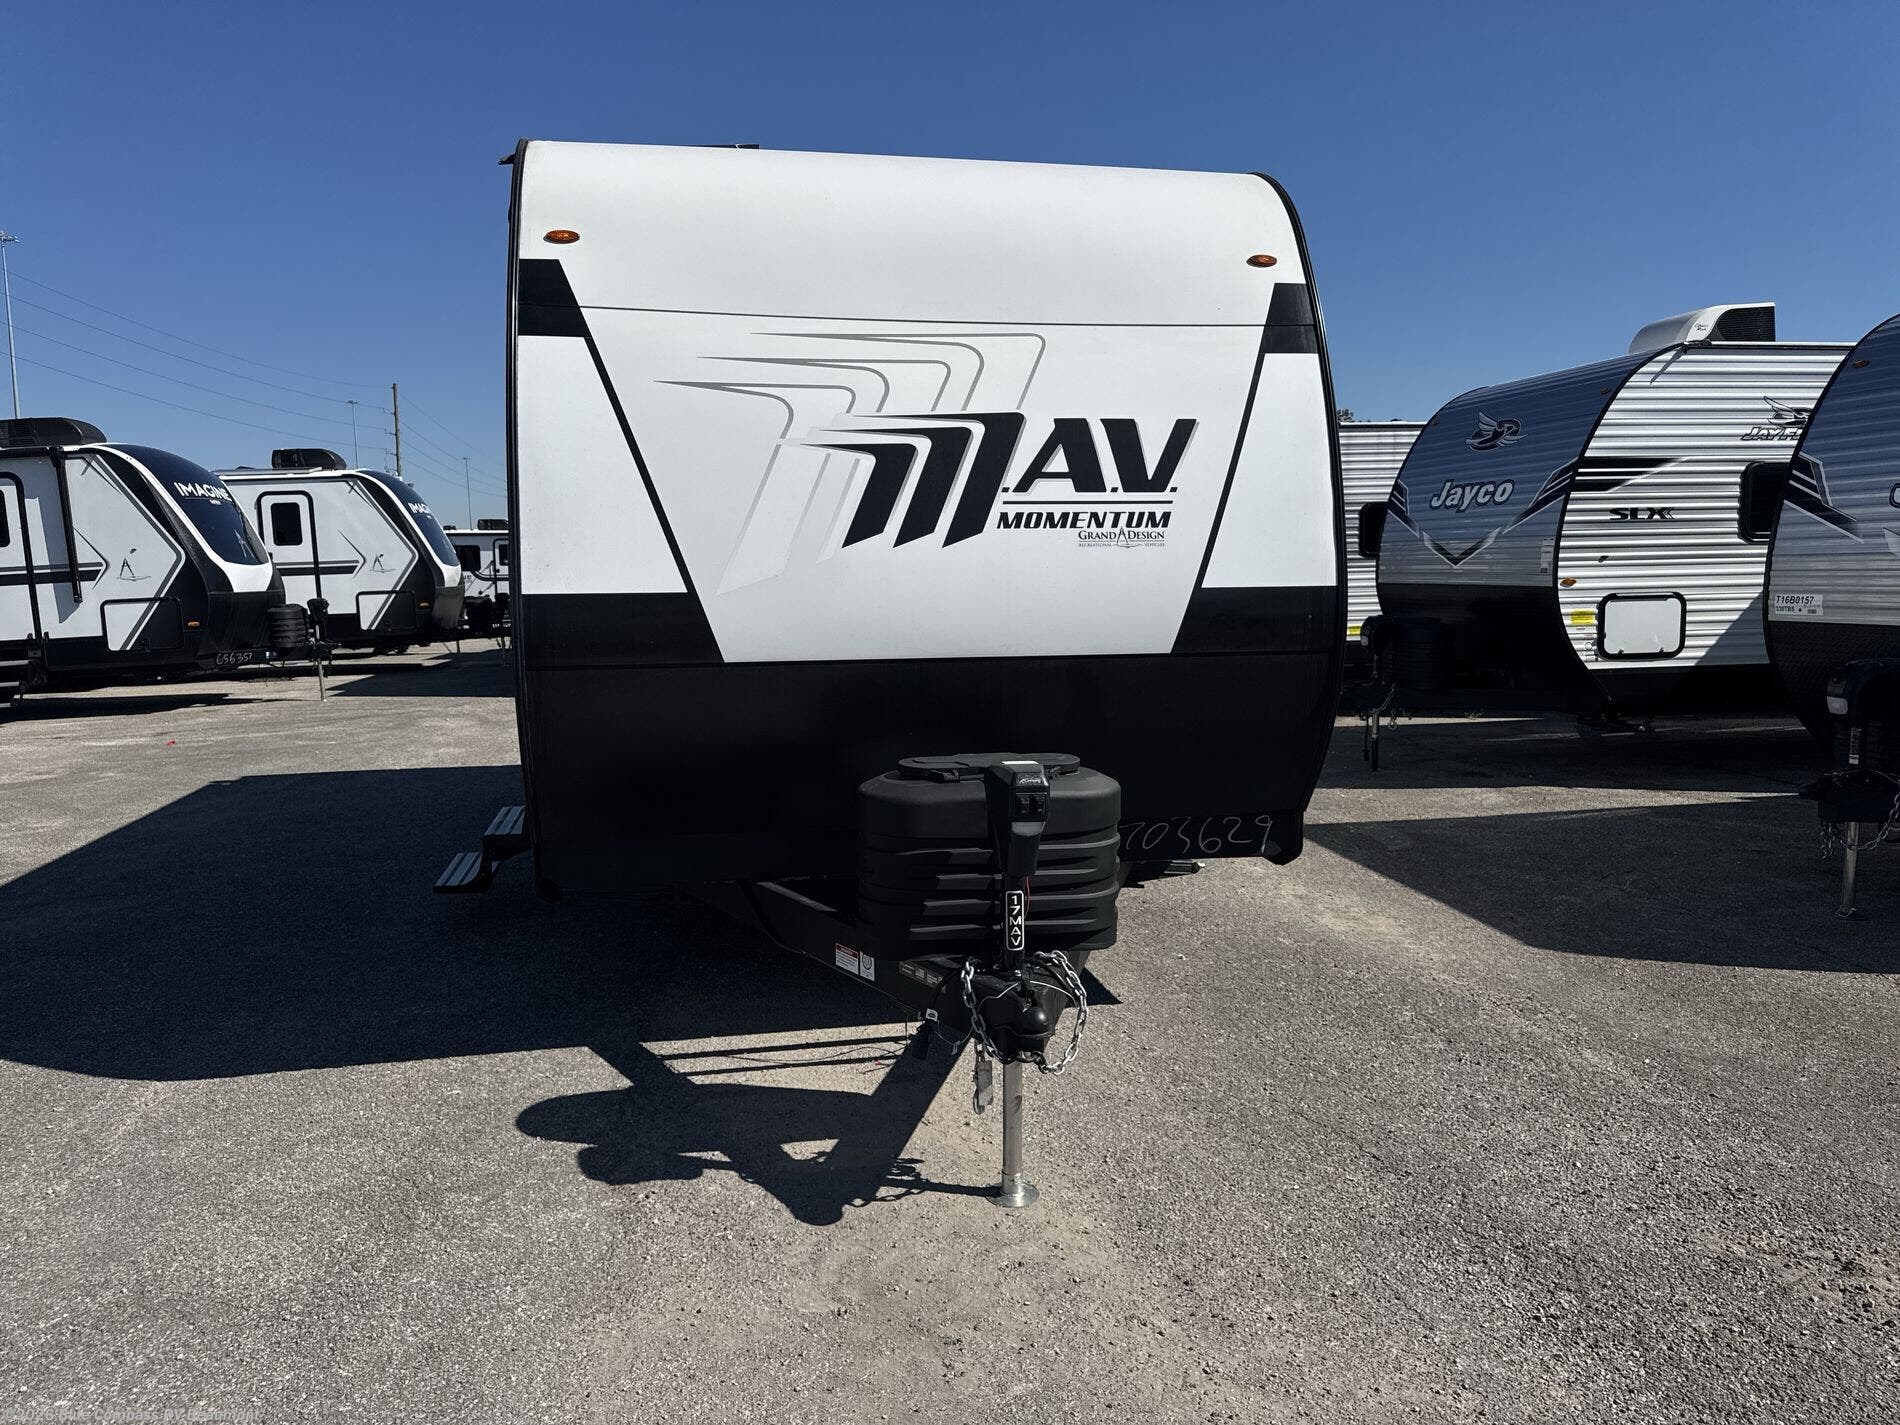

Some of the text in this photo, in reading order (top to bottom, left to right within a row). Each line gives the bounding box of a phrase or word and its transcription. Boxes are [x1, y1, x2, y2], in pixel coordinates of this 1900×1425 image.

[1740, 427, 1783, 441] JAY
[173, 482, 232, 502] IMAGINE
[1430, 477, 1515, 514] Jayco
[996, 511, 1172, 529] MOMENTUM
[1078, 530, 1165, 540] GRAND DESIGN
[1775, 595, 1815, 605] T16B0157
[1119, 814, 1273, 854] 703629
[1008, 894, 1022, 947] 17MAV
